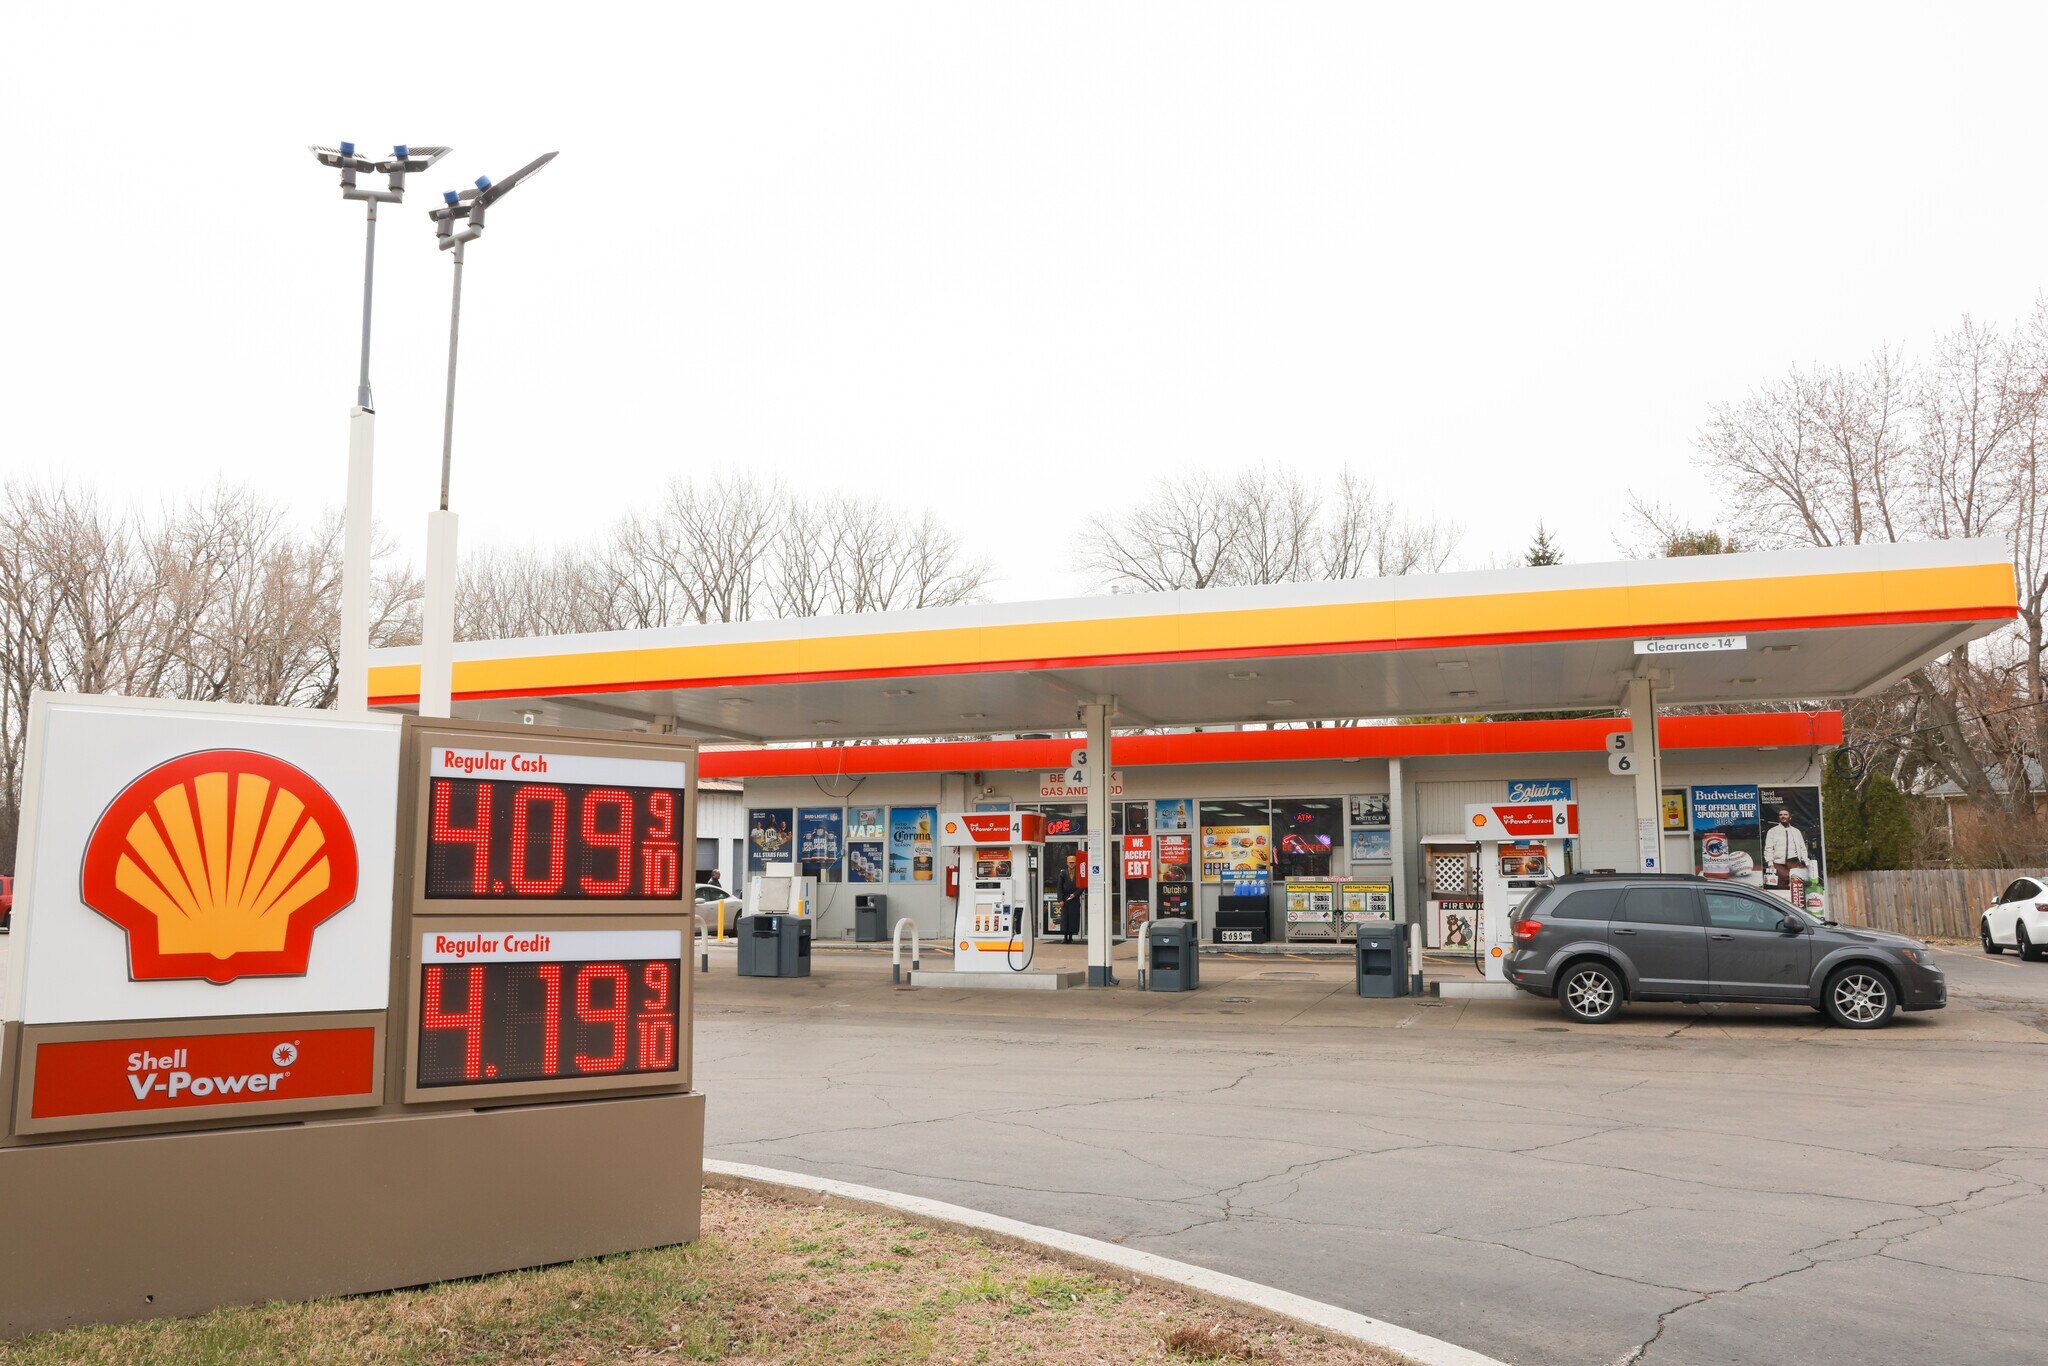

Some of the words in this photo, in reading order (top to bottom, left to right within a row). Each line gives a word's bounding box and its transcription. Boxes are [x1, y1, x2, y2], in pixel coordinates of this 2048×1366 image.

[1646, 640, 1709, 653] Clearance
[1615, 735, 1626, 749] 5
[444, 749, 507, 773] Regular
[511, 754, 548, 774] Cash
[1077, 751, 1088, 765] 3
[1618, 756, 1631, 770] 6
[1072, 770, 1083, 783] 4
[1040, 787, 1064, 796] GAS
[1065, 786, 1089, 796] AND
[1509, 783, 1550, 802] Salud
[1695, 790, 1756, 801] Budweiser
[1694, 804, 1708, 812] THE
[1738, 803, 1757, 811] BEER
[1296, 813, 1312, 821] ATM
[1555, 812, 1566, 825] 6
[1697, 811, 1730, 819] SPONSOR
[848, 825, 883, 838] VAPE
[1011, 822, 1021, 833] 4
[893, 830, 931, 843] Corona
[1132, 838, 1144, 848] WE
[1124, 850, 1152, 860] ACCEPT
[1127, 861, 1149, 876] EBT
[1163, 885, 1182, 894] Dutch
[435, 935, 499, 958] Regular
[503, 934, 551, 955] Credit
[127, 1047, 187, 1072] Shell
[127, 1069, 284, 1100] V-Power
